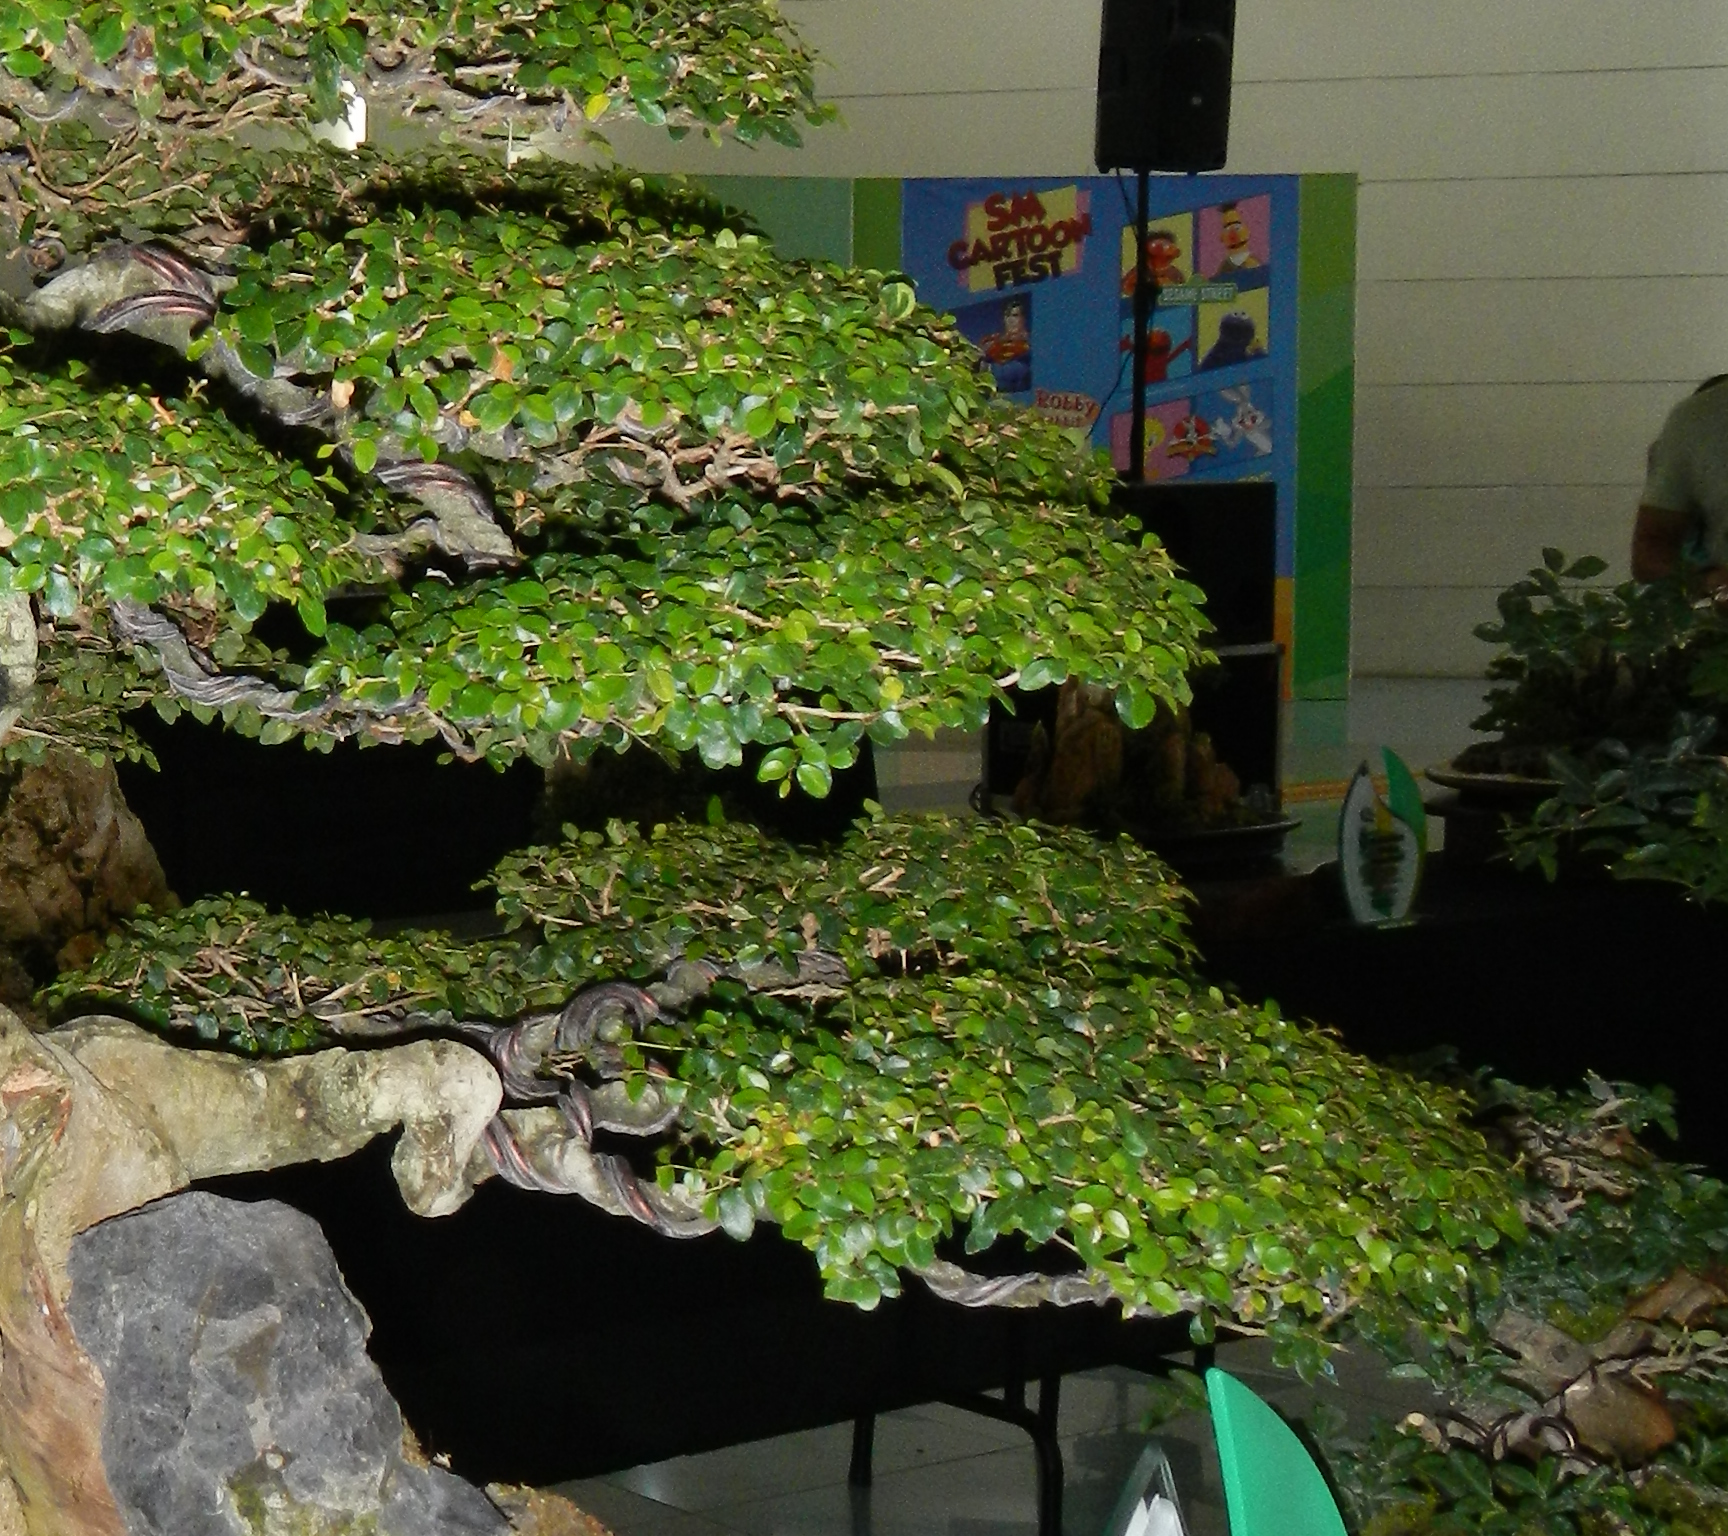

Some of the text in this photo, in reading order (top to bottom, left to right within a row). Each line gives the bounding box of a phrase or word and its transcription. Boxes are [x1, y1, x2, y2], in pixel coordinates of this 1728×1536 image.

[984, 191, 1047, 232] SM
[948, 213, 1092, 270] CARTOON
[993, 249, 1062, 290] FEST
